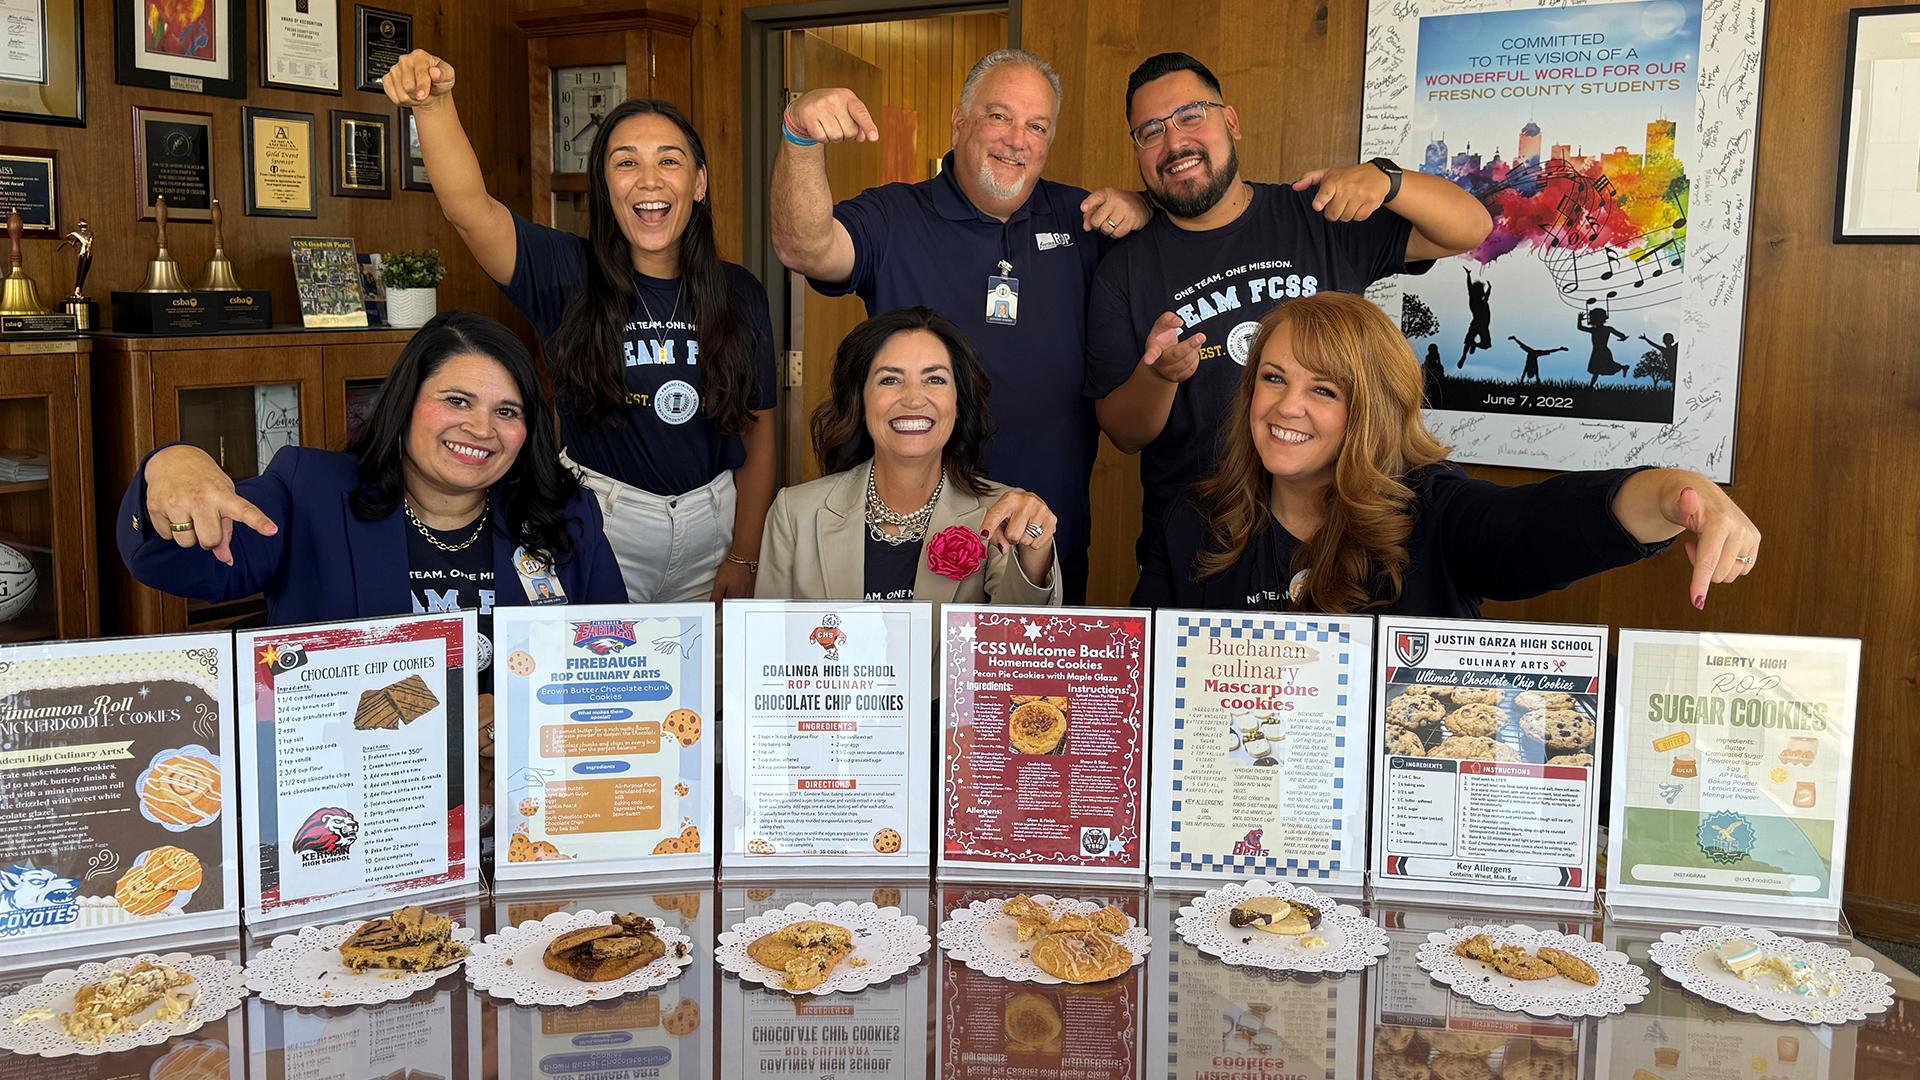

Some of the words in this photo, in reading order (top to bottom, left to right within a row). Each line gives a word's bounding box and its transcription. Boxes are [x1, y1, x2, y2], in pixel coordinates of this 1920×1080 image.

[1501, 33, 1605, 50] COMMITTED
[1469, 56, 1492, 68] TO
[1496, 53, 1530, 66] THE
[1534, 50, 1591, 64] VISION
[1597, 48, 1622, 62] OF
[1625, 47, 1639, 60] A
[575, 73, 582, 85] 11
[592, 72, 601, 84] 12
[1424, 70, 1530, 86] WONDERFUL
[1535, 66, 1598, 80] WORLD
[1603, 64, 1640, 77] FOR
[1645, 62, 1687, 74] OUR
[1428, 87, 1496, 101] FRESNO
[1500, 83, 1576, 98] COUNTY
[1580, 79, 1681, 94] STUDENTS
[561, 92, 571, 104] 10
[563, 116, 570, 128] 9
[563, 140, 571, 152] 8
[577, 157, 584, 170] 7
[1173, 287, 1196, 301] ONE
[1195, 273, 1224, 290] TEAM.
[1225, 265, 1248, 278] ONE
[1249, 260, 1293, 272] MISSION.
[172, 297, 190, 306] csba
[229, 296, 246, 304] csba
[1176, 285, 1242, 331] EAM
[1248, 274, 1318, 304] FCSS
[637, 320, 664, 330] TEAM.
[665, 320, 686, 330] ONE
[623, 339, 676, 368] EAM
[1200, 344, 1226, 361] EST.
[1482, 394, 1515, 406] June
[1519, 395, 1534, 409] 7,
[1536, 396, 1574, 409] 2022
[409, 570, 447, 579] TEAM.
[450, 568, 477, 581] ONE
[886, 589, 907, 600] ONE
[576, 622, 635, 643] EAGLES
[817, 631, 834, 639] CHS
[1208, 637, 1306, 659] Buchanan
[1434, 634, 1475, 646] JUSTIN
[1479, 636, 1516, 648] GARZA
[1520, 638, 1547, 650] HIGH
[1551, 640, 1594, 651] SCHOOL
[970, 641, 1007, 655] FCSS
[1009, 642, 1076, 657] Welcome
[1080, 644, 1125, 659] Back!!
[566, 656, 647, 670] FIREBAUGH
[988, 656, 1055, 669] Homemade
[1056, 658, 1103, 670] Cookies
[1459, 657, 1516, 668] CULINARY
[1520, 660, 1549, 670] ARTS
[1706, 655, 1755, 668] LIBERTY
[1759, 658, 1787, 669] HIGH
[300, 664, 360, 682] CHOCOLATE
[364, 661, 388, 675] CHIP
[393, 656, 435, 672] COOKIES
[550, 672, 574, 682] ROP
[576, 670, 630, 681] CULINARY
[632, 669, 661, 679] ARTS
[762, 665, 819, 677] COALINGA
[823, 665, 850, 677] HIGH
[853, 665, 896, 677] SCHOOL
[1211, 659, 1300, 686] culinary
[972, 669, 997, 678] Pecan
[998, 670, 1011, 678] Pie
[1012, 670, 1045, 680] Cookies
[1046, 671, 1066, 680] with
[1066, 672, 1093, 683] Maple
[1095, 673, 1118, 682] Glaze
[1415, 670, 1459, 684] Ultimate
[1461, 671, 1509, 687] Chocolate
[1512, 674, 1535, 691] Chip
[1537, 675, 1575, 691] Cookies
[570, 686, 599, 694] Butter
[600, 684, 643, 693] Chocolate
[643, 683, 670, 692] chunk
[788, 679, 811, 689] ROP
[815, 680, 874, 690] CULINARY
[966, 680, 1014, 692] Ingredients:
[1067, 683, 1130, 695] Instructions:
[1204, 679, 1319, 699] Mascarpone
[1711, 672, 1781, 696] ROP
[589, 693, 622, 701] Cookies
[754, 694, 821, 711] CHOCOLATE
[824, 694, 851, 711] CHIP
[855, 694, 904, 711] COOKIES
[89, 695, 134, 718] Roll
[1220, 697, 1295, 712] cookies
[1648, 693, 1726, 725] SUGAR
[1730, 697, 1829, 732] COOKIES
[0, 714, 115, 735] NICKERDOODLE
[119, 708, 181, 726] COOKIES
[802, 722, 853, 730] INGREDIENTS
[27, 754, 52, 764] High
[54, 749, 98, 761] Culinary
[99, 747, 125, 757] Arts!
[1743, 752, 1764, 760] Sugar
[1405, 761, 1443, 769] INGREDIENTS
[1483, 766, 1531, 775] INSTRUCTIONS
[20, 766, 81, 778] snickerdoodle
[50, 776, 82, 785] buttery
[83, 773, 108, 781] finish
[805, 781, 851, 789] DIRECTIONS
[1708, 778, 1731, 786] Baking
[1732, 779, 1758, 787] Powder
[17, 790, 36, 798] with
[45, 787, 65, 796] mini
[66, 785, 108, 794] cinnamon
[109, 781, 125, 789] roll
[15, 799, 50, 809] drizzled
[51, 797, 71, 805] with
[72, 794, 96, 803] sweet
[98, 792, 121, 800] white
[977, 797, 992, 807] Key
[966, 806, 1003, 816] Allergens:
[302, 846, 350, 862] KERMAN
[302, 860, 320, 868] HIGH
[321, 855, 351, 864] SCHOOL
[1456, 862, 1472, 871] Key
[1473, 864, 1512, 874] Allergens
[1474, 872, 1493, 880] Wheat,
[0, 904, 80, 930] COYOTES
